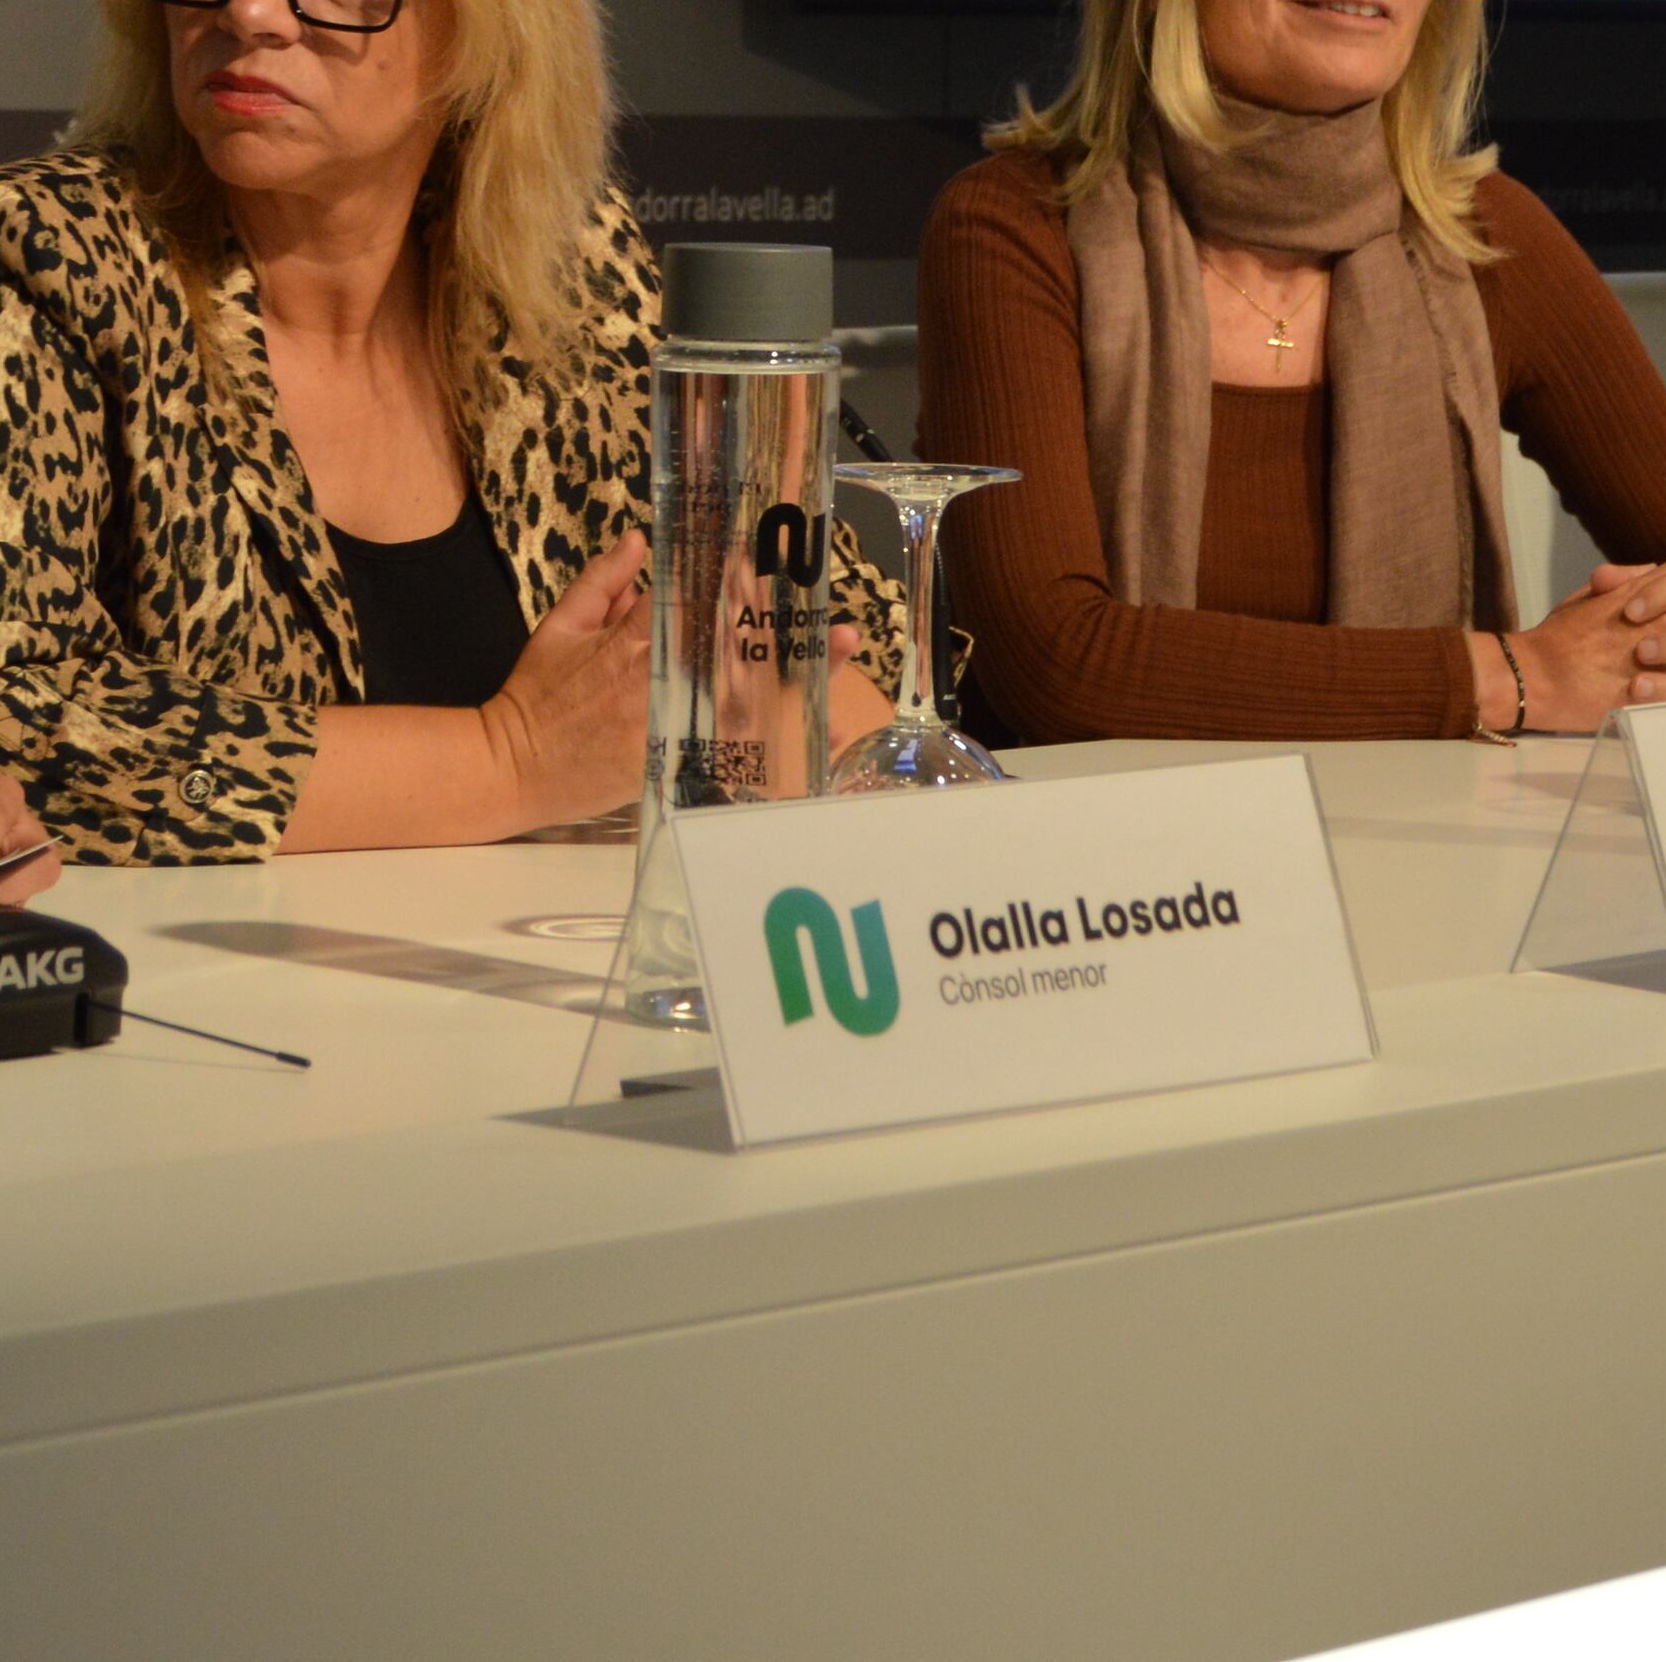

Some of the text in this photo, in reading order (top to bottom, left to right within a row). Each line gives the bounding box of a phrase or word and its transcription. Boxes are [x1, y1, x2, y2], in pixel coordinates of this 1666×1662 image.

[634, 186, 835, 222] dorralavella.ad
[740, 639, 768, 662] la
[929, 881, 1241, 959] Olalla Losada
[1032, 963, 1107, 995] menor
